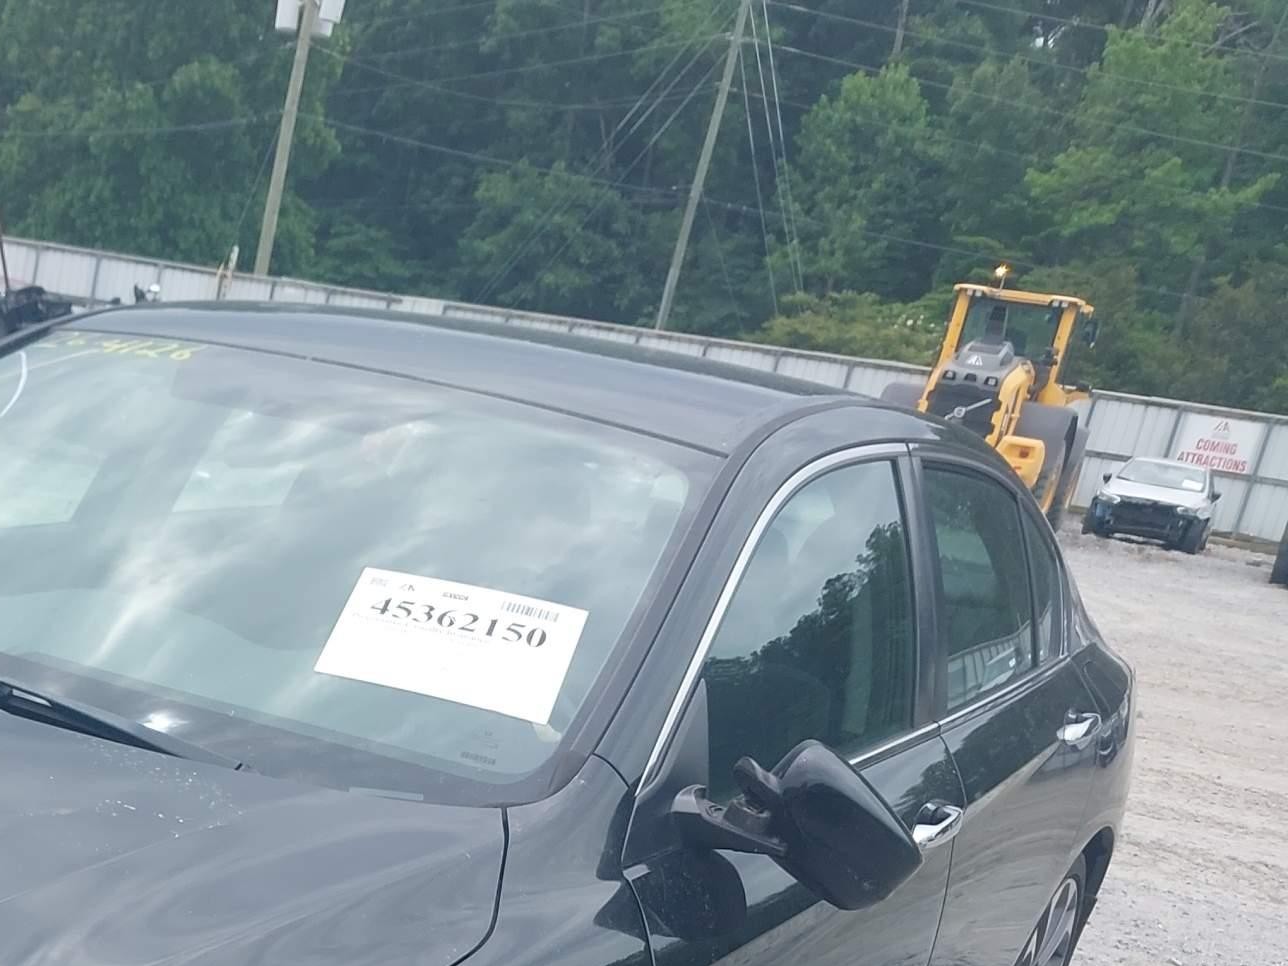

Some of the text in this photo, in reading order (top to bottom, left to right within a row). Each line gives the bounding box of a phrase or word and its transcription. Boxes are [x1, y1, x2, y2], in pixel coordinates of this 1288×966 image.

[1195, 438, 1238, 455] COMING
[1177, 451, 1247, 472] ATTRACTIONS
[370, 597, 548, 648] 45362150
